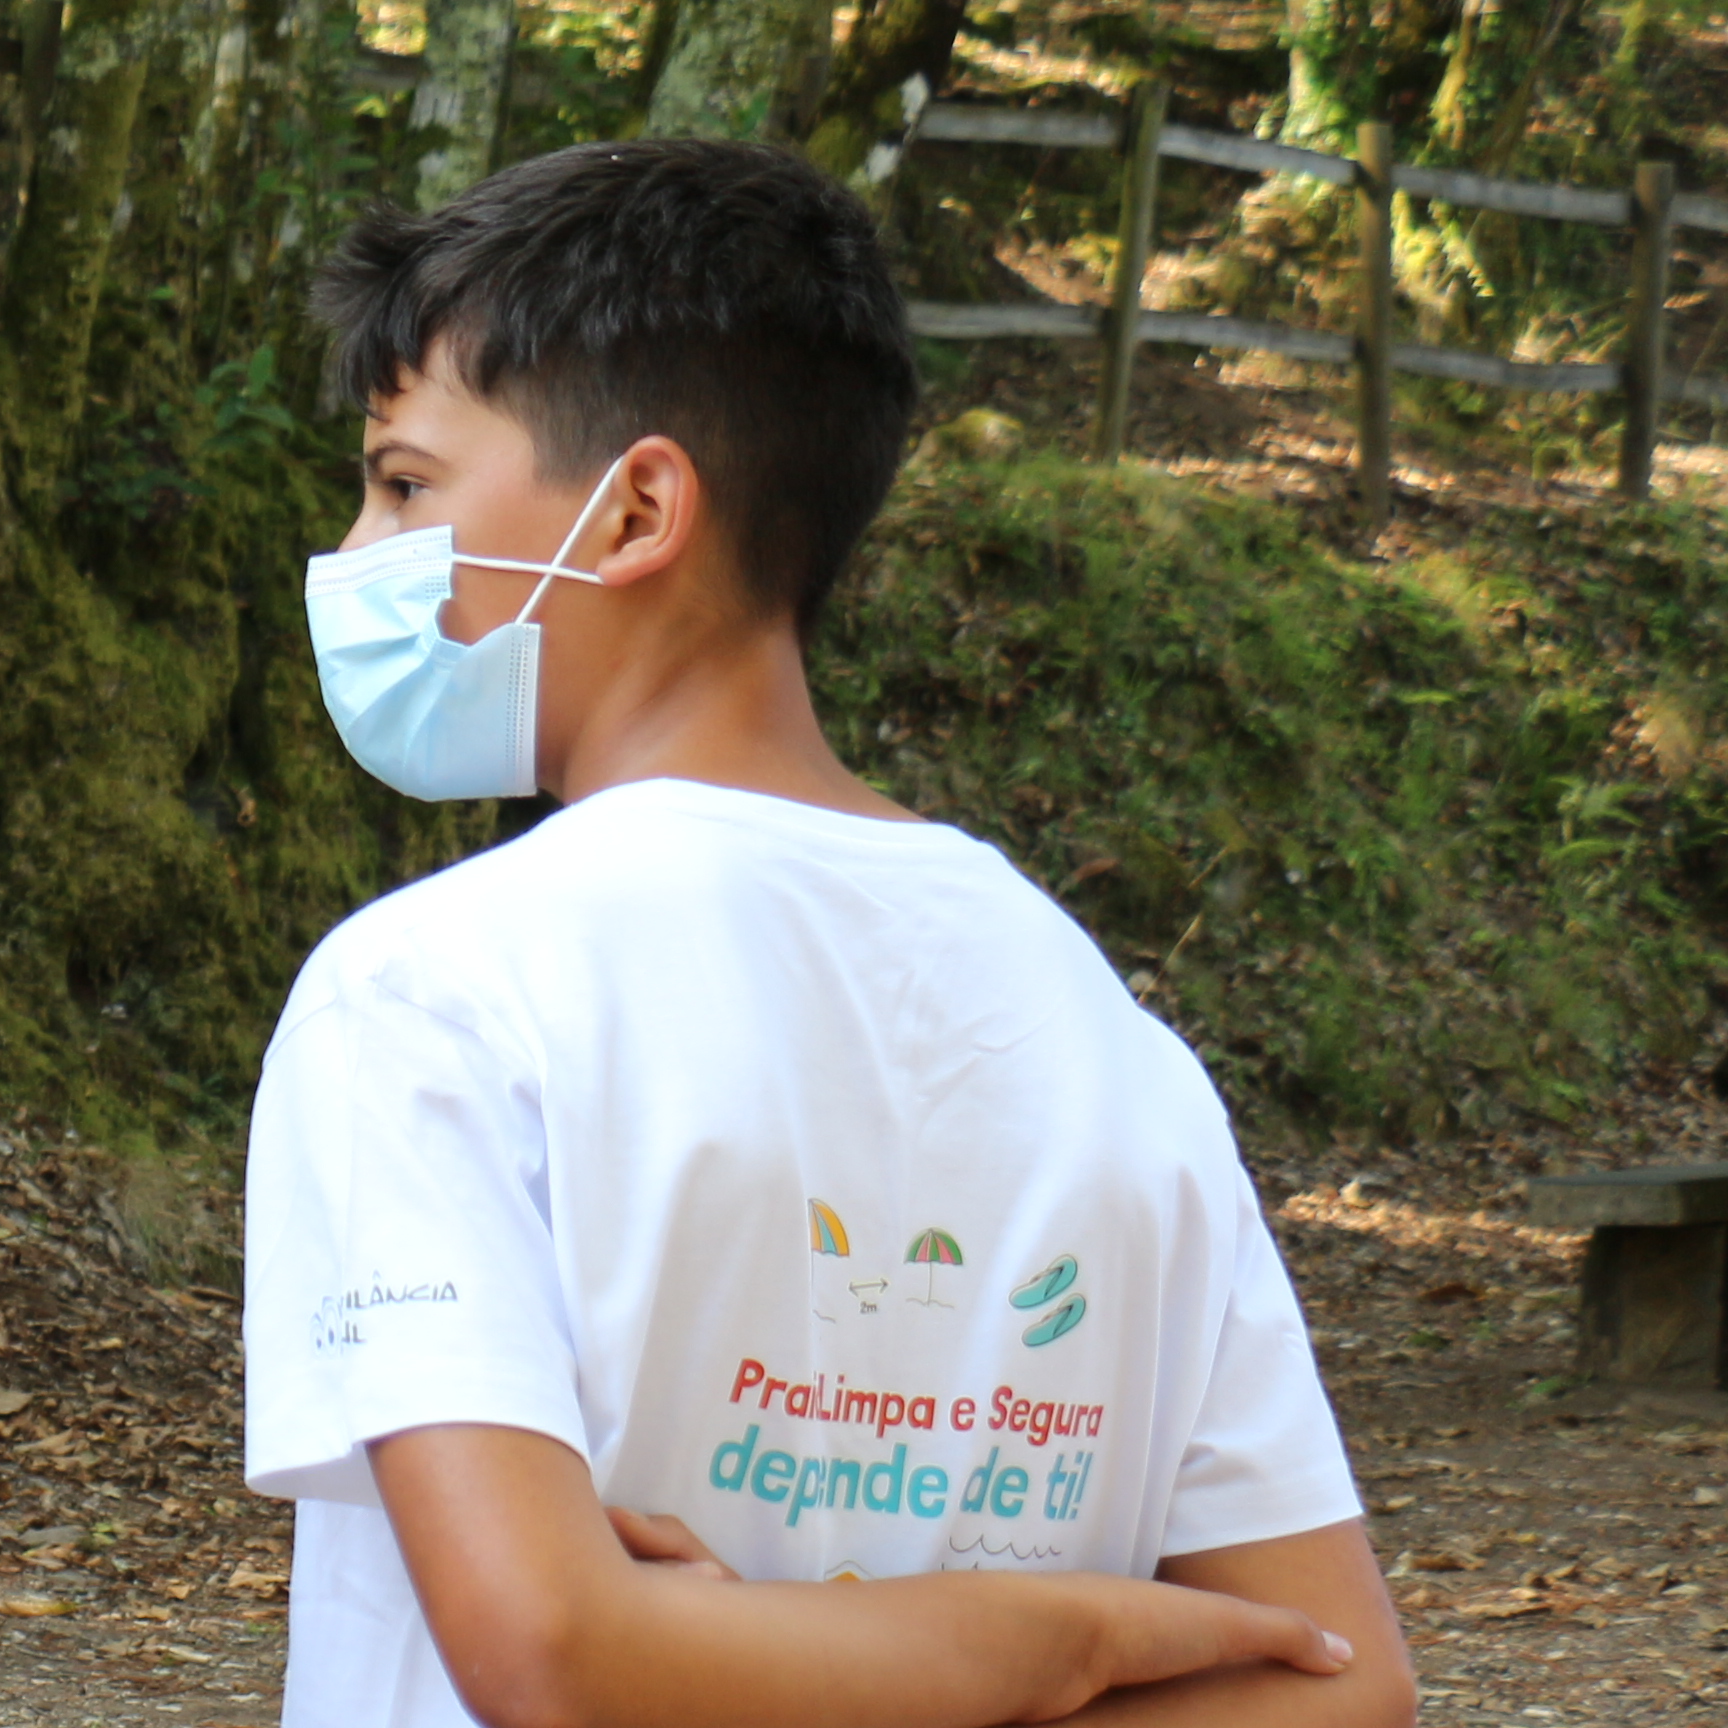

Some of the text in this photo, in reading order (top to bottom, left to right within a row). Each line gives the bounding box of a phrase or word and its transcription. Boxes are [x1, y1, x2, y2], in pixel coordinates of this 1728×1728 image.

[860, 1301, 877, 1314] 2m
[817, 1373, 935, 1438] Limpa
[949, 1397, 975, 1432] e
[988, 1386, 1103, 1447] Segura
[960, 1447, 1030, 1518] de
[1044, 1451, 1093, 1520] ti!
